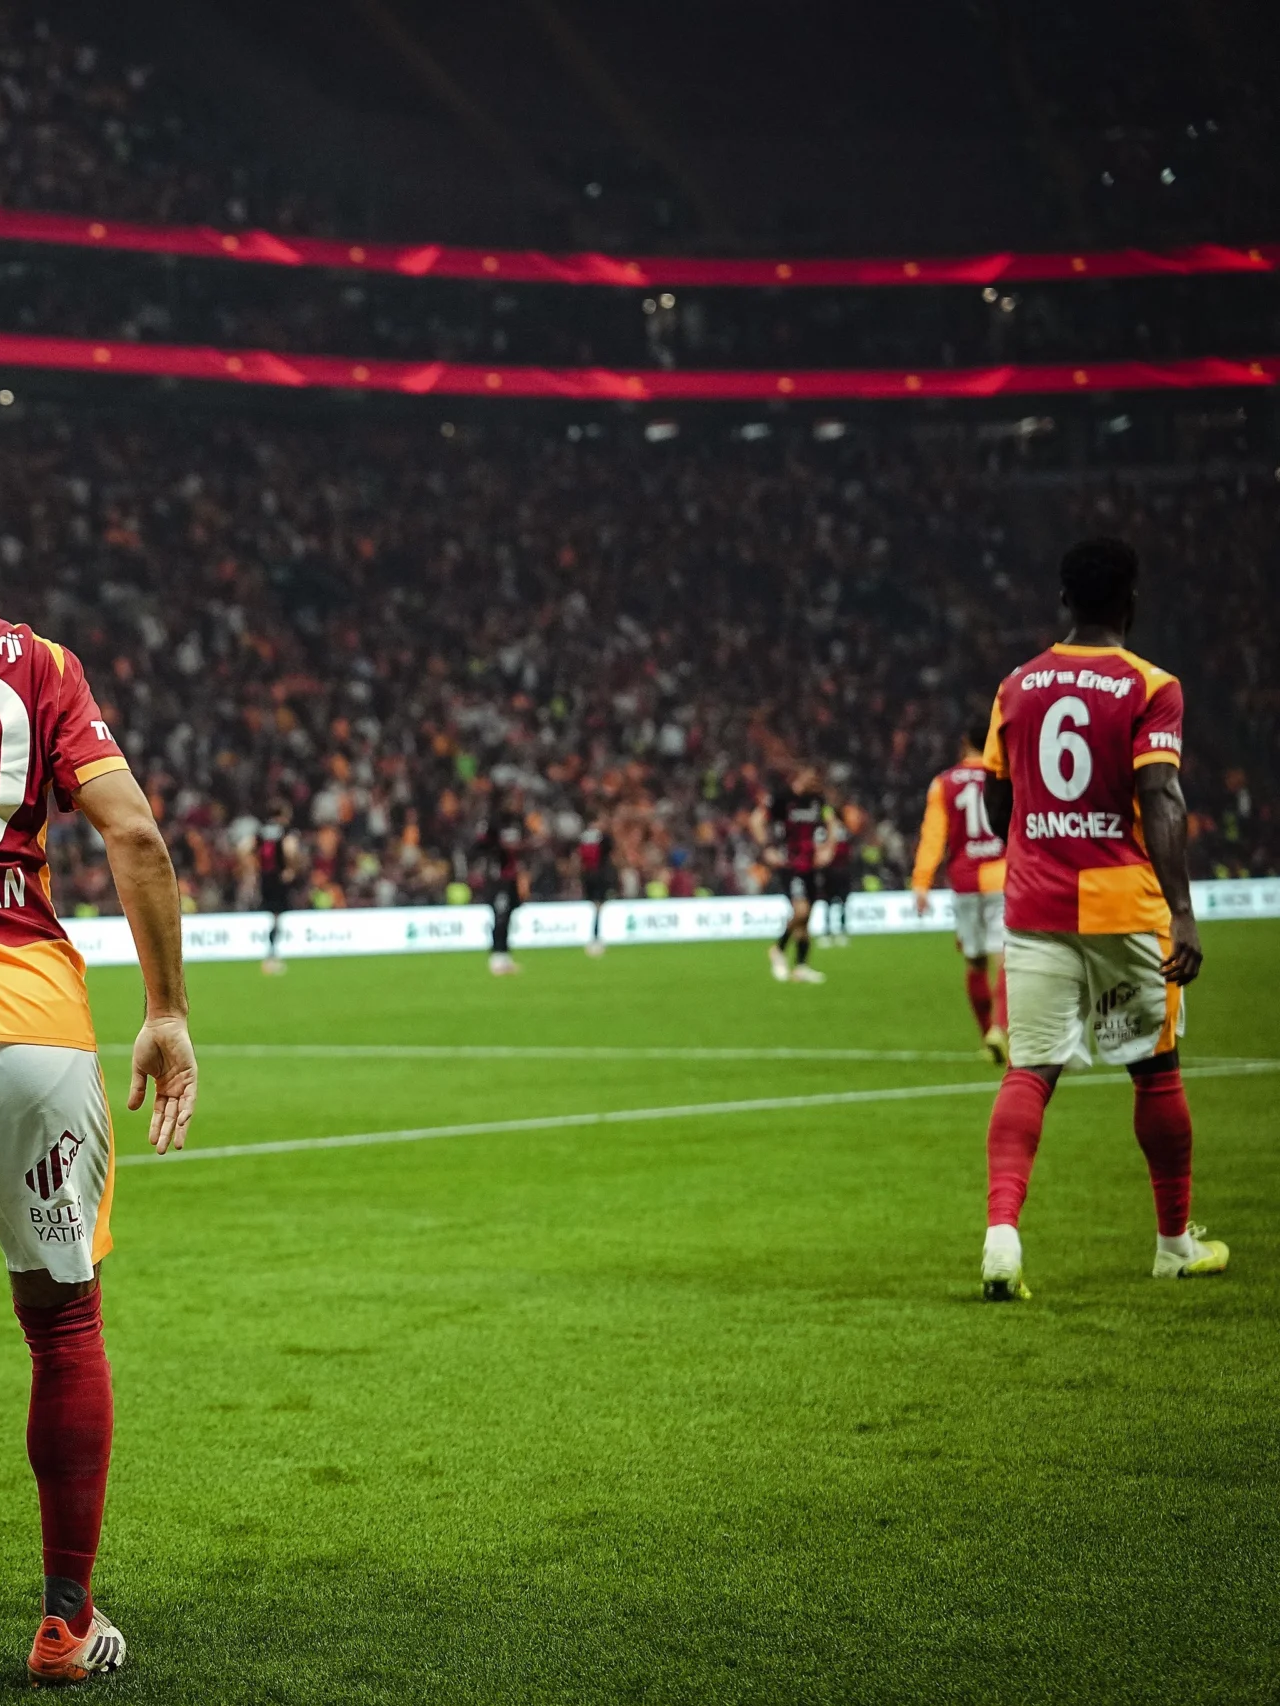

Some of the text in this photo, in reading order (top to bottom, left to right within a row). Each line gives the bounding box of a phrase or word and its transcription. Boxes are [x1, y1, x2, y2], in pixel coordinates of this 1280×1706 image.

[1021, 669, 1056, 690] CW
[1038, 696, 1093, 801] 6
[955, 782, 994, 838] 1
[1026, 811, 1123, 839] SANCHEZ
